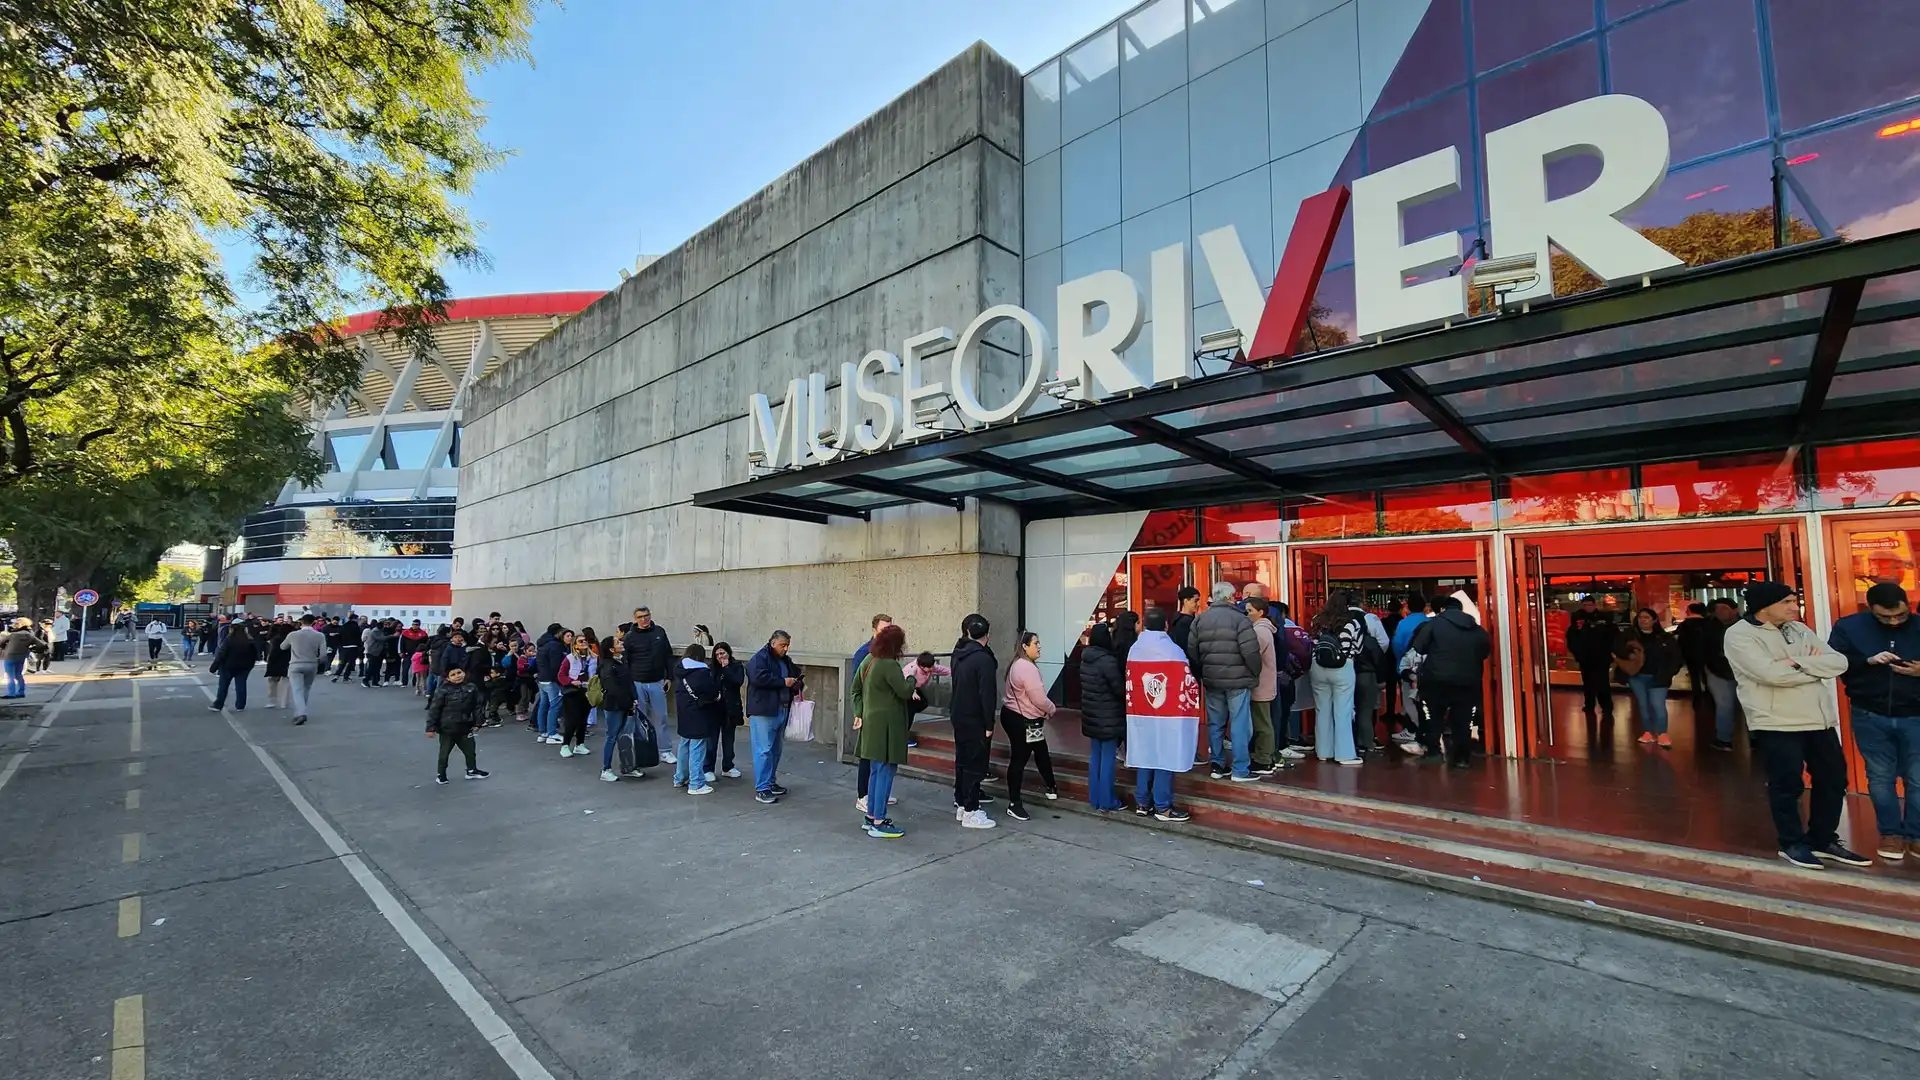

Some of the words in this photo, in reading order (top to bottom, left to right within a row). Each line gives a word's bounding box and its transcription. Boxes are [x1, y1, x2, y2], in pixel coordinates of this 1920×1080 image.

[749, 304, 1049, 477] MUSEO
[1057, 93, 1686, 404] RIVER
[380, 564, 437, 580] codere
